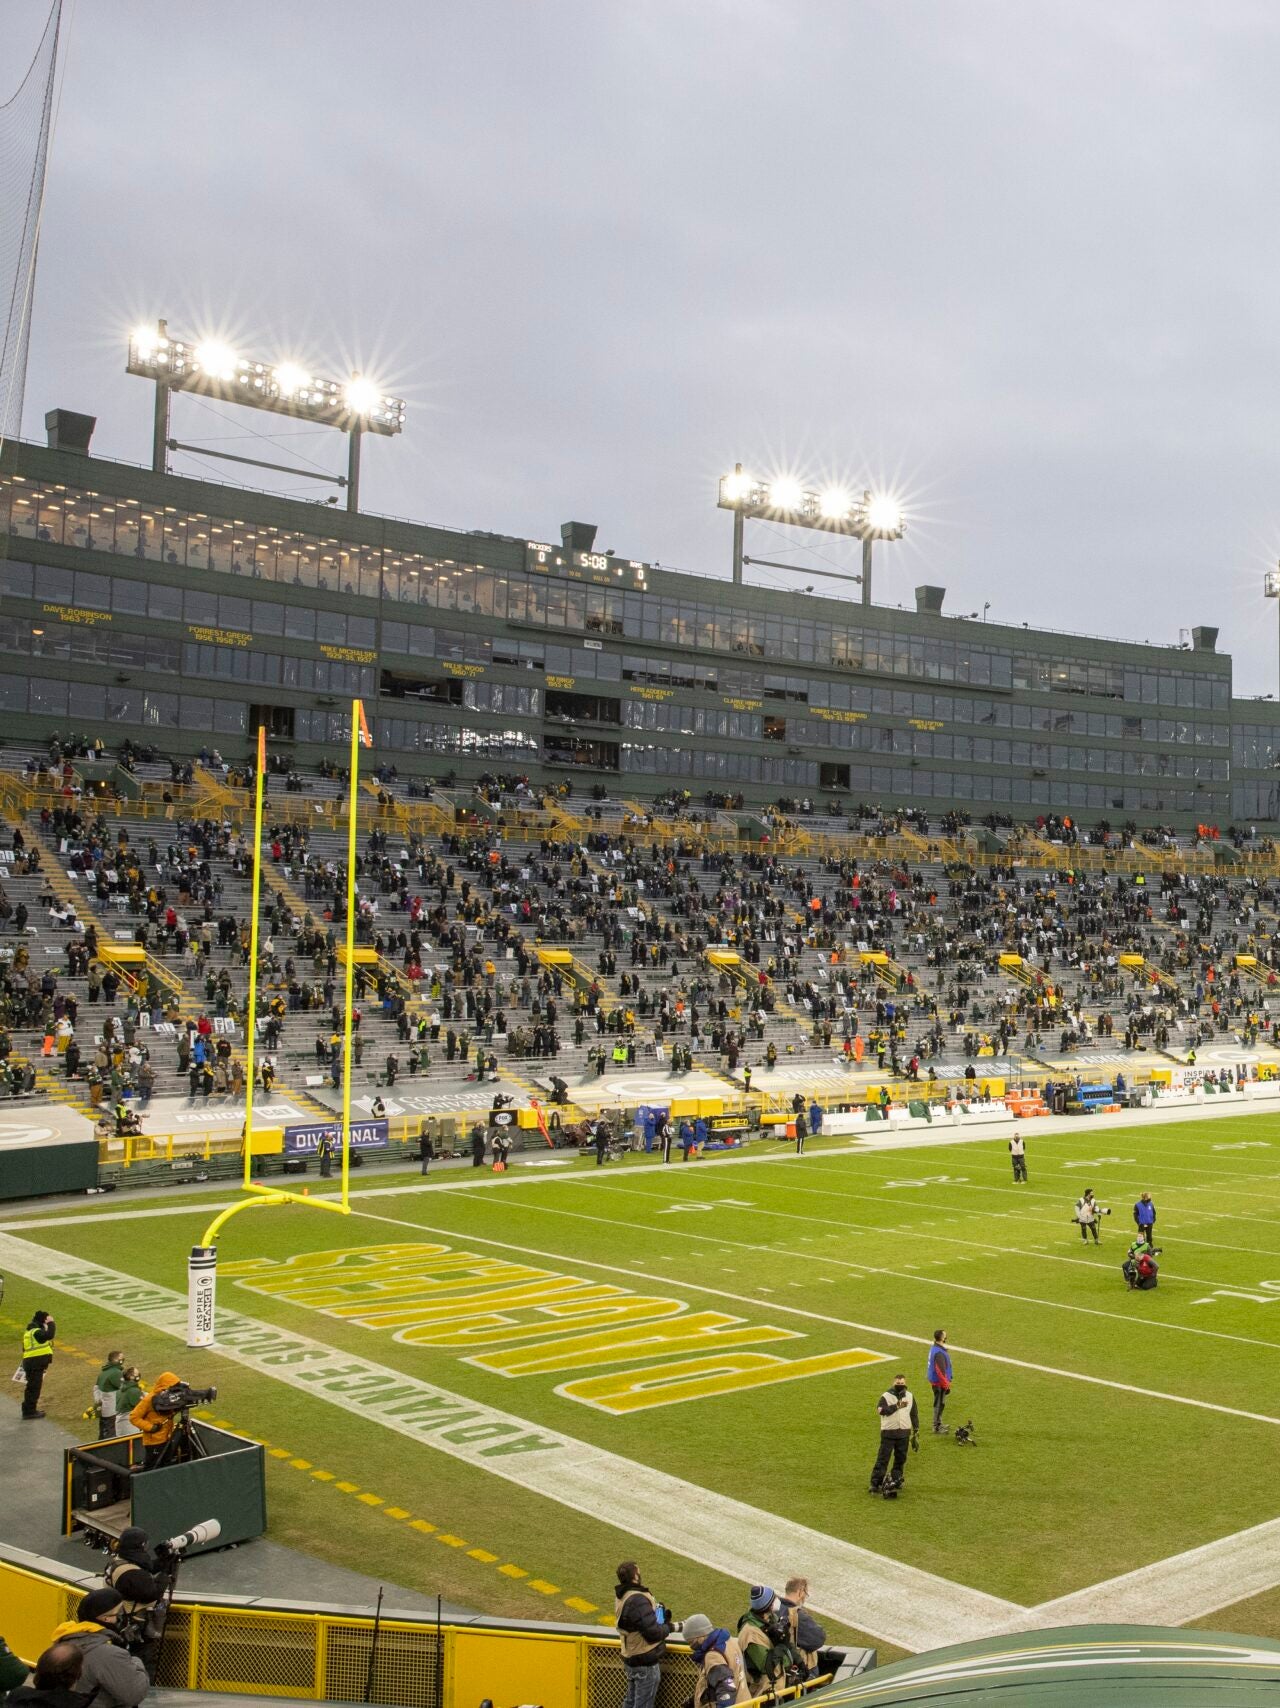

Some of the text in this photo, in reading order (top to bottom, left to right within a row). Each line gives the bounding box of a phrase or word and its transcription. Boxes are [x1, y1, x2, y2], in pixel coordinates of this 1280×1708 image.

[527, 542, 552, 552] PACKERS
[538, 552, 546, 562] 0
[580, 553, 607, 570] 5:08
[637, 569, 644, 580] 0
[43, 604, 112, 621] DAVE ROBINSON
[189, 626, 253, 641] FORREST GREGG
[443, 662, 484, 673] WILLIE WOOD
[399, 1091, 515, 1105] CONCORDIA
[176, 1108, 291, 1123] FABICK CAT
[295, 1127, 381, 1148] DIVSINAL
[890, 1175, 969, 1188] 20
[671, 1198, 758, 1212] 10
[45, 1270, 188, 1312] JUSTICE
[196, 1288, 212, 1332] INSPIRE CHANGE
[217, 1242, 899, 1415] PACKERS
[302, 1367, 564, 1458] ADVANCE
